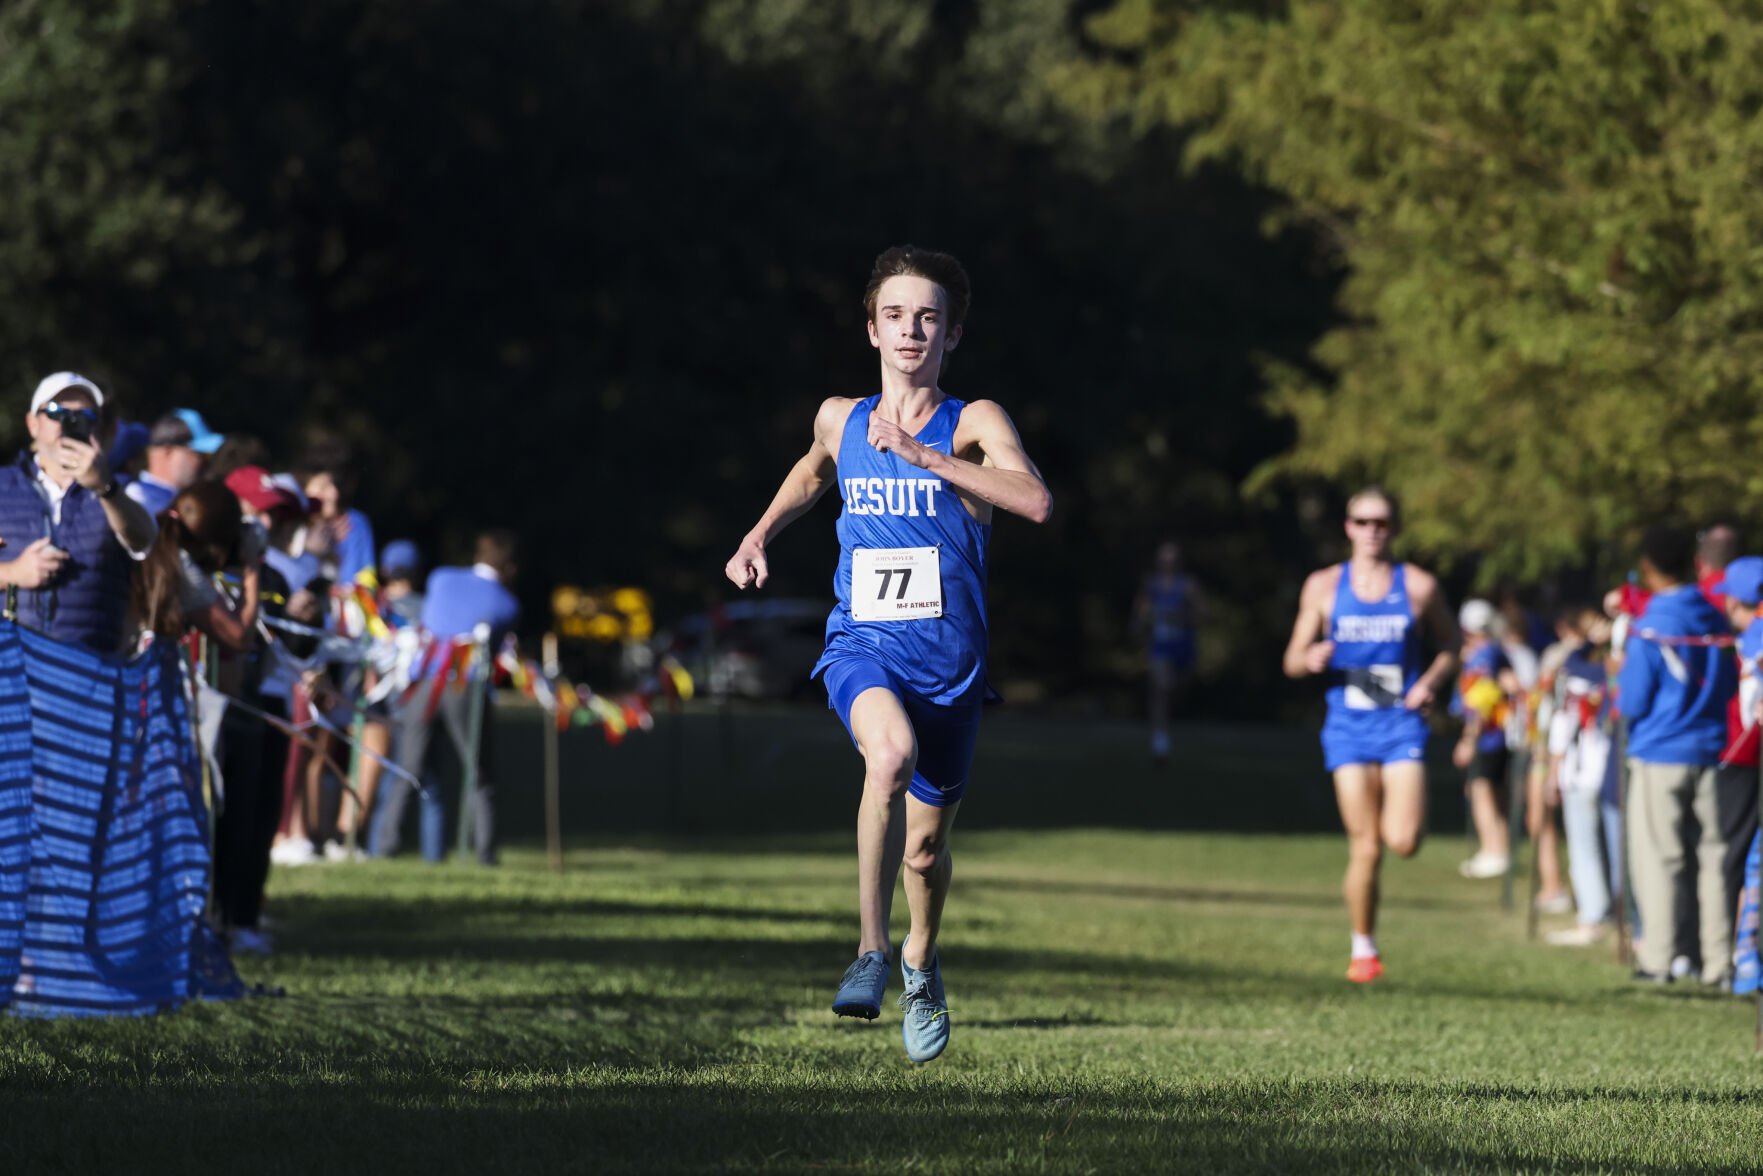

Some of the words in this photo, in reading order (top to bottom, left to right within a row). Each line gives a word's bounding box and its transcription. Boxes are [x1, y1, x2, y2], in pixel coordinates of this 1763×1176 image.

[844, 477, 942, 517] JESUIT
[874, 568, 912, 600] 77
[910, 600, 940, 609] ATHLETIC
[1334, 614, 1409, 643] JESUIT
